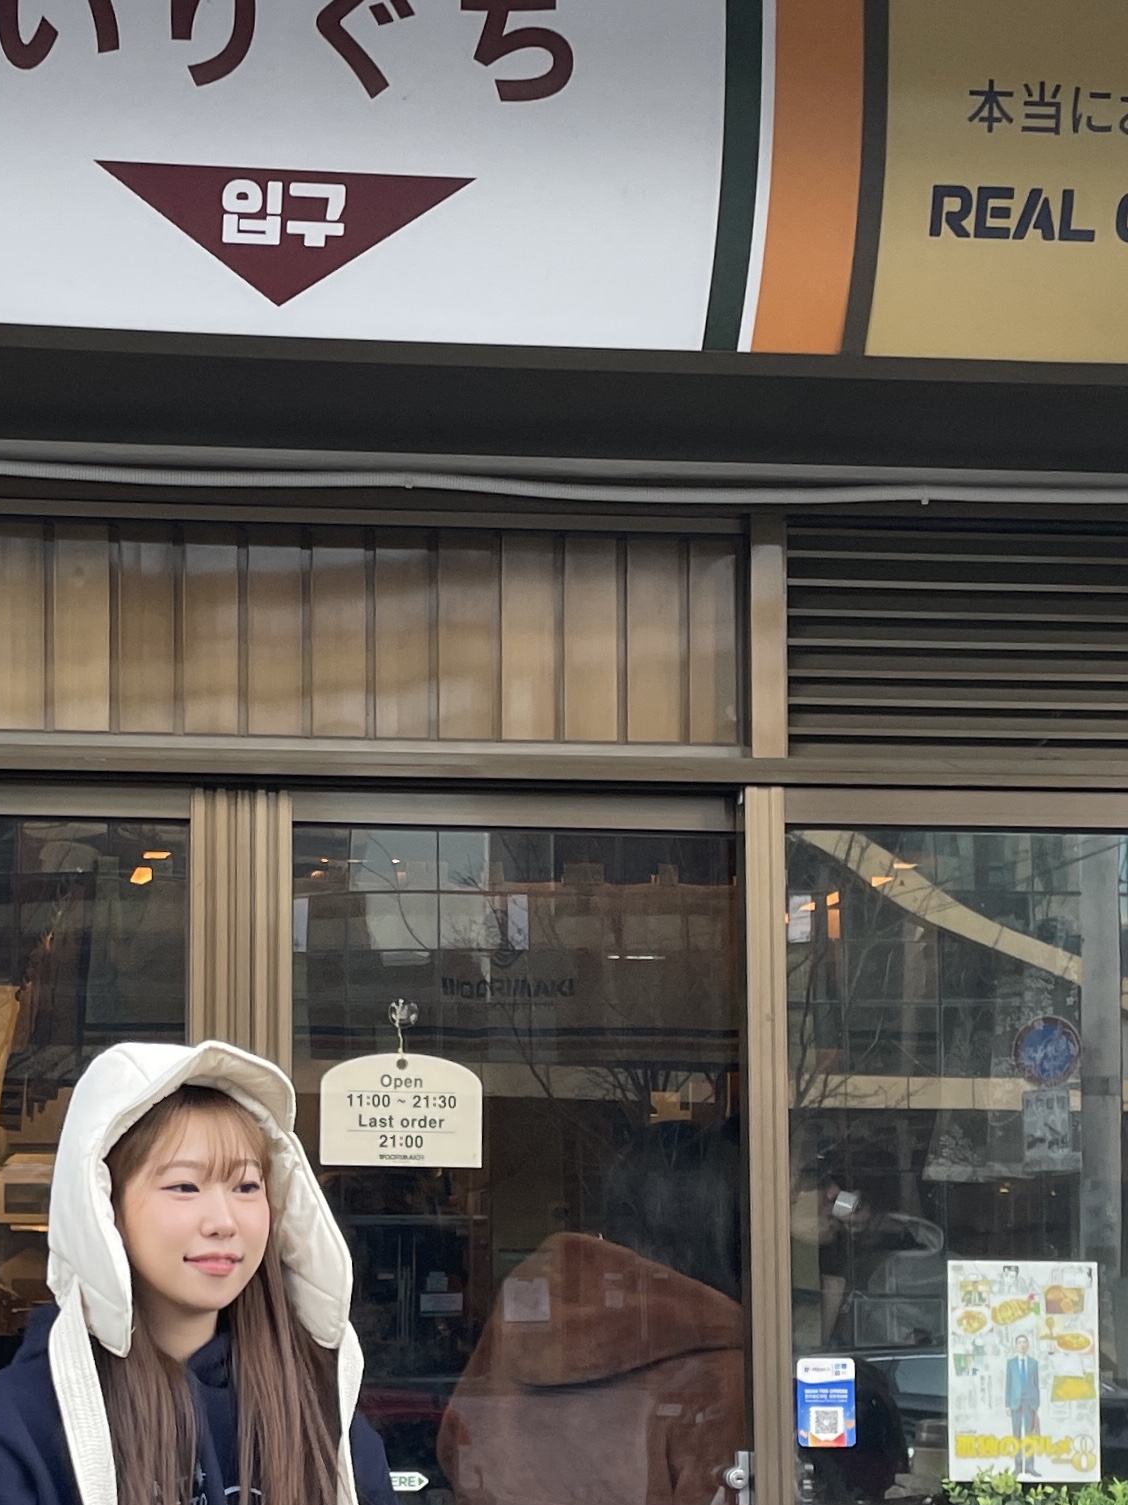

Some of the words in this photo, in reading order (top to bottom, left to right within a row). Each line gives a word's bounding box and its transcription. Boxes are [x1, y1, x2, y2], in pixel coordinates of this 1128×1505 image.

[967, 78, 1128, 137] 本当に
[221, 178, 347, 248] 입구
[930, 184, 1096, 243] REAL
[380, 1074, 423, 1090] Open
[347, 1094, 391, 1108] 11:00
[412, 1095, 458, 1109] 21:30
[358, 1114, 394, 1128] Last
[400, 1116, 445, 1129] order
[379, 1135, 424, 1148] 21:00
[1072, 1434, 1097, 1473] 8
